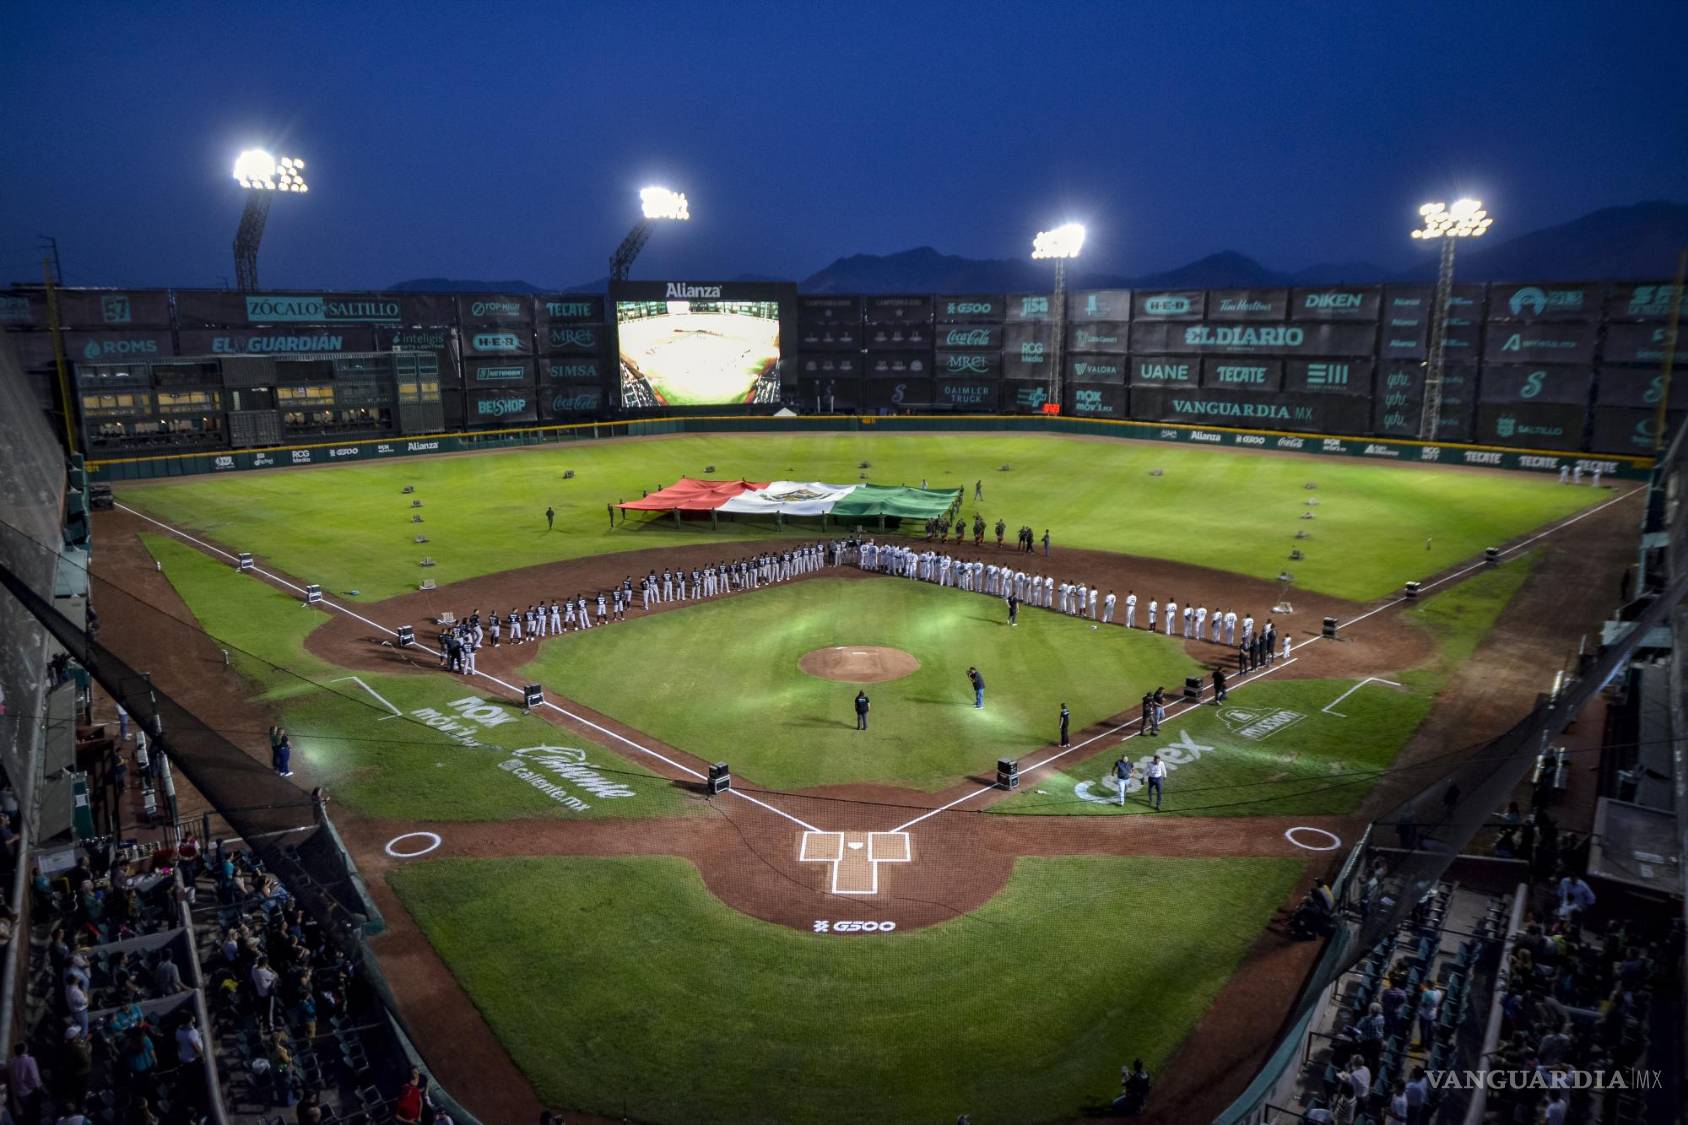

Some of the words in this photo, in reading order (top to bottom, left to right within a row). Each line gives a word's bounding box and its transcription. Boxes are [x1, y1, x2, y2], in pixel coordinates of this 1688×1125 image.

[666, 282, 721, 298] Alianza
[1305, 293, 1362, 307] DIKEN
[250, 299, 318, 315] ZÓCALO
[329, 302, 398, 316] SALTILLO
[546, 303, 592, 316] TECATE
[957, 303, 992, 313] G500
[103, 340, 157, 353] ROMS
[212, 337, 232, 352] EL
[248, 334, 342, 352] GUARDIÁN
[550, 365, 597, 377] SIMSA
[1141, 364, 1189, 380] UANE
[1217, 366, 1267, 383] TECATE
[944, 386, 989, 395] DAIMLER
[952, 394, 982, 402] TRUCK
[1172, 400, 1290, 419] VANGUARDIA
[1191, 430, 1221, 441] Alianza
[408, 441, 438, 451] Alianza
[292, 450, 310, 458] RCG
[1464, 450, 1504, 464] TECATE
[1519, 455, 1560, 469] TECATE
[833, 920, 896, 932] G500
